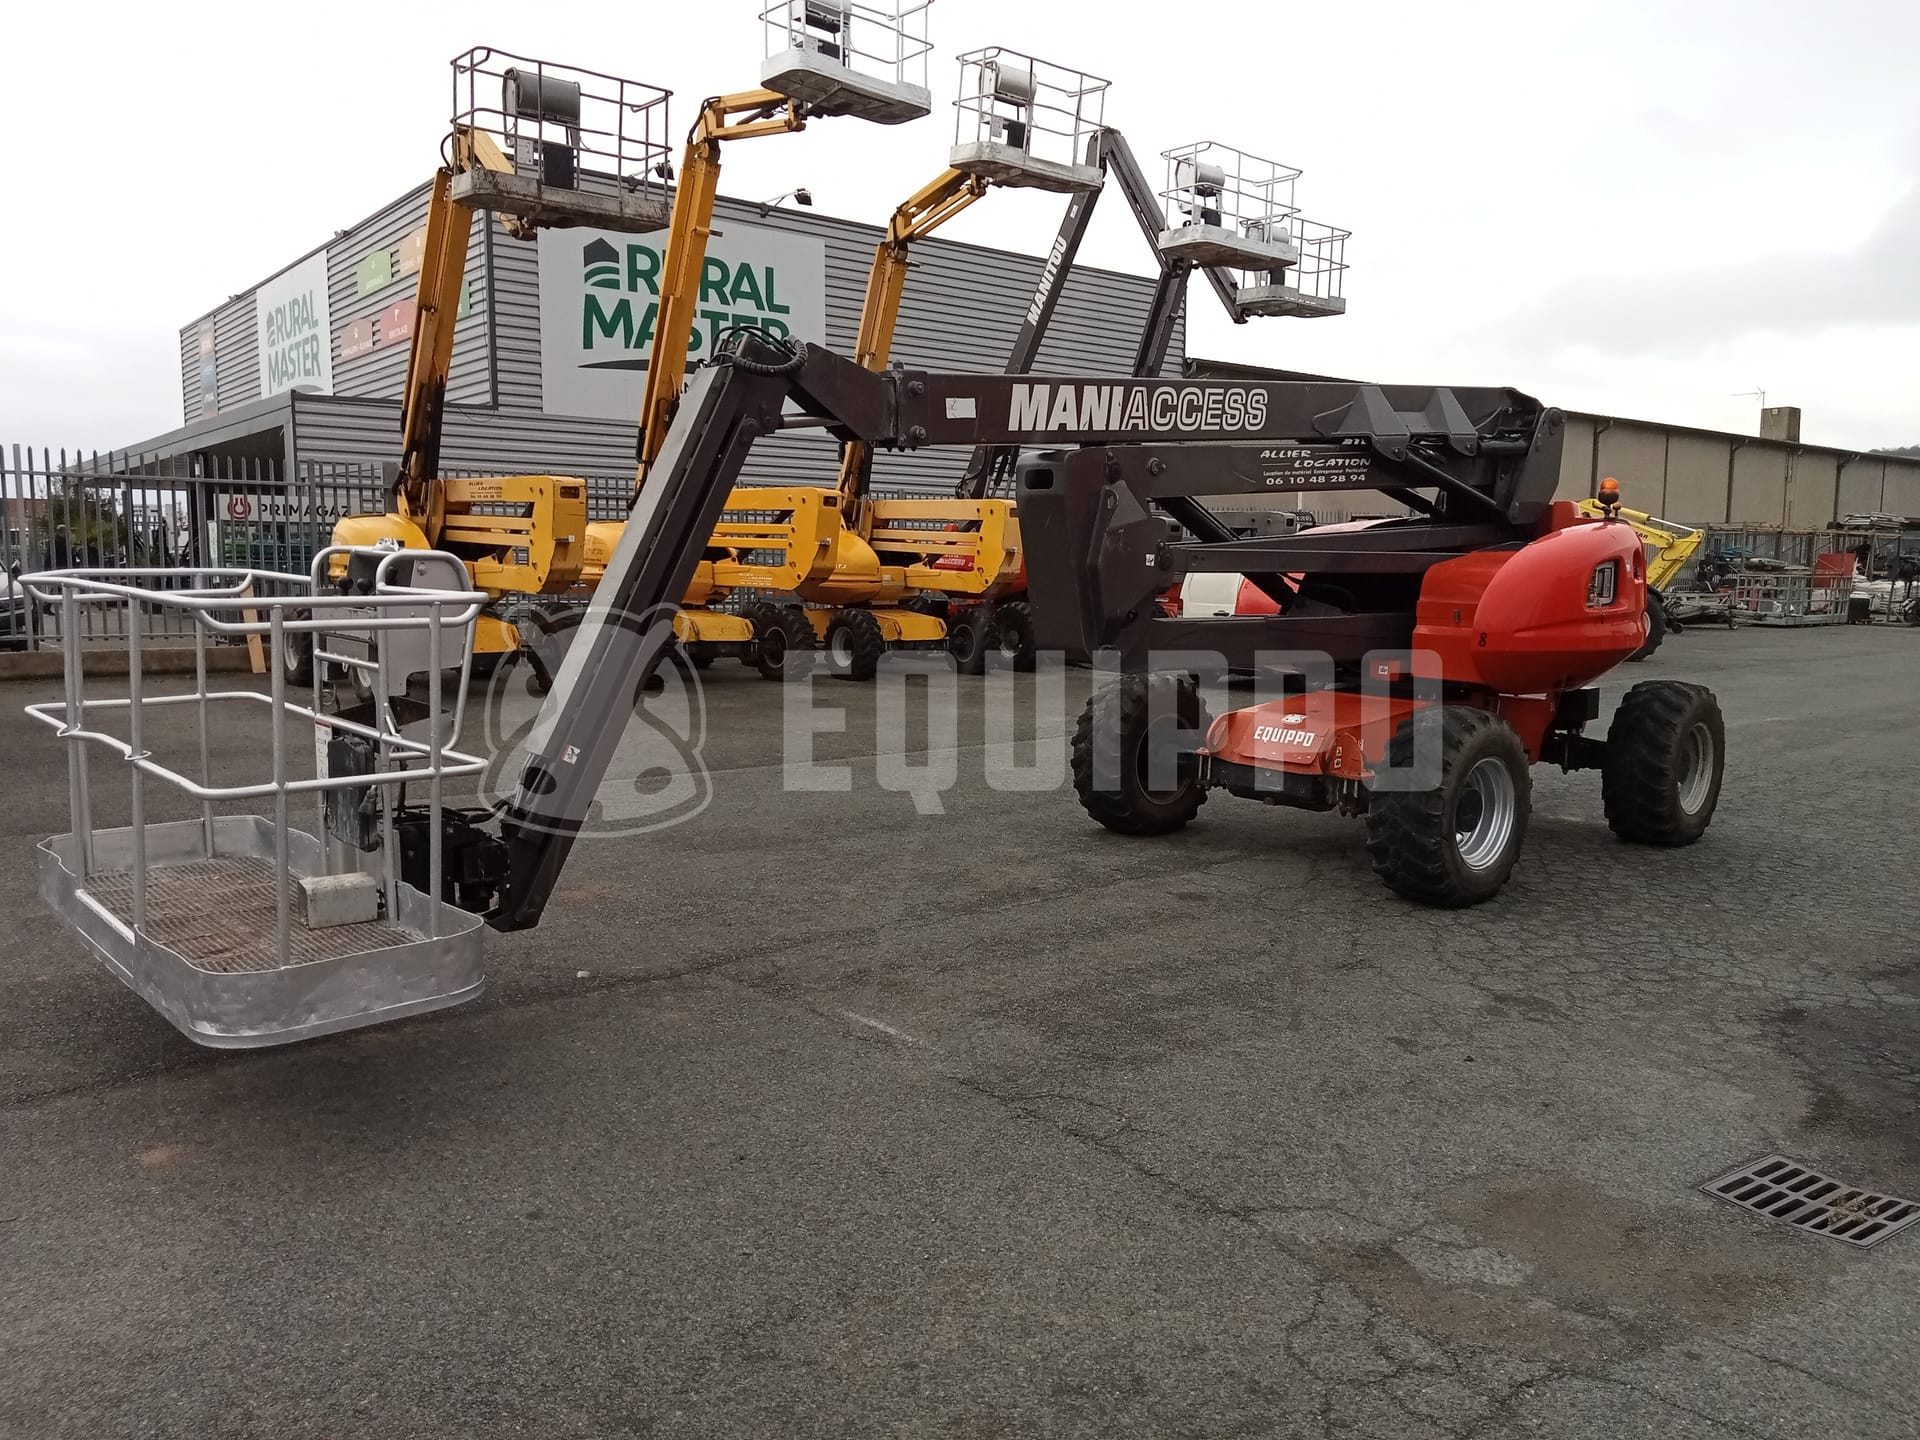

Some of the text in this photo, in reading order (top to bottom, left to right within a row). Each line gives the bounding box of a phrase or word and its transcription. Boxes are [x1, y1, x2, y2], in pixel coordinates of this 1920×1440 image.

[626, 243, 790, 315] RRAL
[1027, 235, 1067, 327] MANITOU
[275, 289, 319, 345] RURAL
[268, 333, 322, 395] MASTER
[1007, 383, 1269, 432] MANIACCESS
[1260, 450, 1312, 458] ALLIER
[1294, 458, 1371, 468] LOCATION
[1266, 473, 1366, 485] 06 10 48 28 94
[260, 502, 352, 518] PRIMAGAZ
[1478, 632, 1488, 648] 8
[1253, 725, 1316, 748] EQUIPPO
